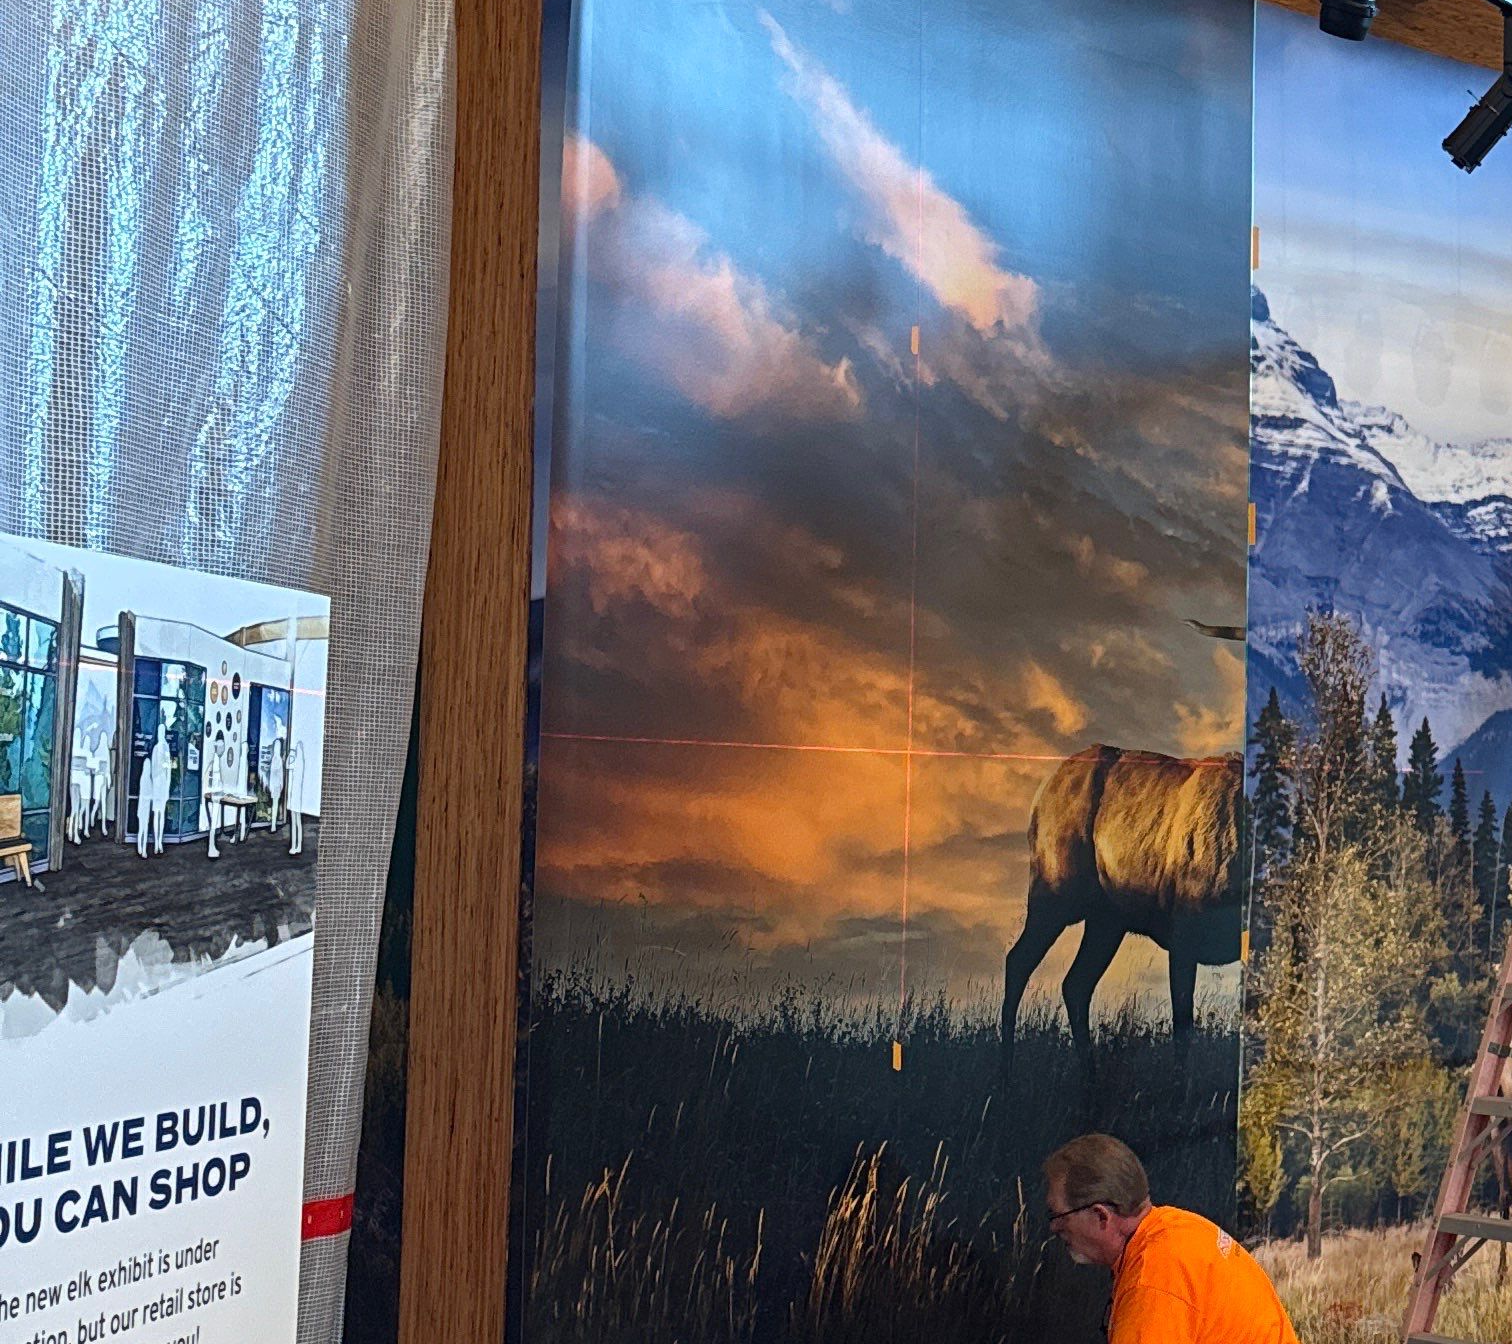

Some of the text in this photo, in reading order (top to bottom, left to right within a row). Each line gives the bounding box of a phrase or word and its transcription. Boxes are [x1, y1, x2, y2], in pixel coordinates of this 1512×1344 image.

[0, 1096, 271, 1186] ILE WE BUILD,
[54, 1175, 139, 1234] CAN
[148, 1152, 251, 1210] SHOP
[25, 1283, 63, 1315] new
[67, 1269, 93, 1301] elk
[98, 1251, 154, 1293] exhibit
[158, 1248, 171, 1276] is
[175, 1237, 220, 1271] under
[110, 1308, 139, 1336] our
[142, 1287, 184, 1325] retail
[187, 1281, 227, 1310] store
[230, 1271, 242, 1298] is
